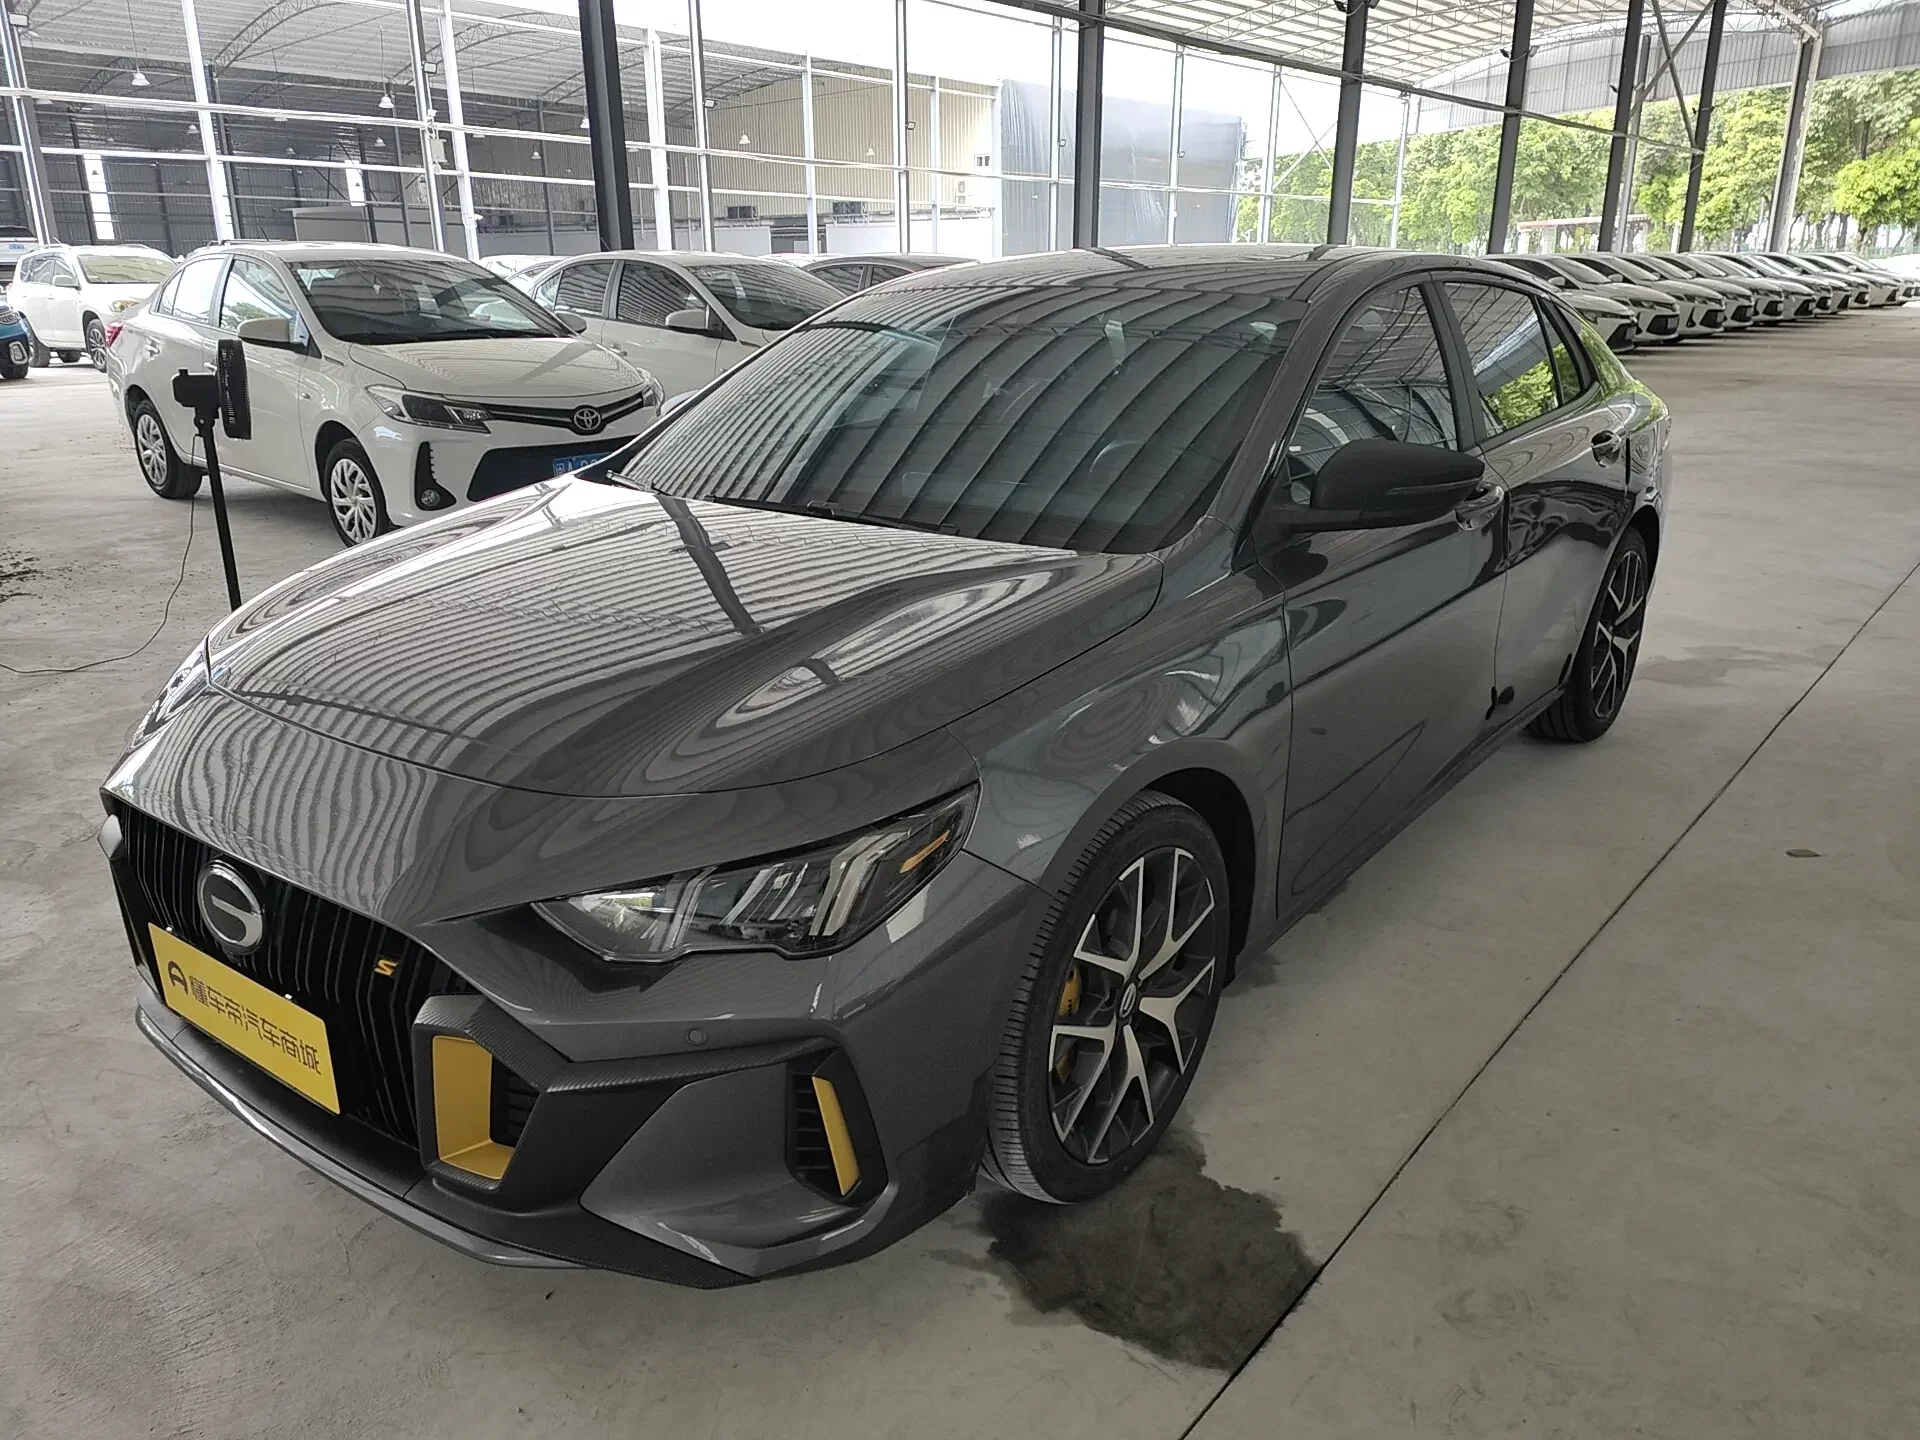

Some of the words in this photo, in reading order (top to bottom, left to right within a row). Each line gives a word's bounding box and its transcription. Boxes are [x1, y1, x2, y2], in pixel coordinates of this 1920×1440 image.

[374, 959, 399, 976] S
[189, 975, 322, 1076] 懂车帝汽车商城
